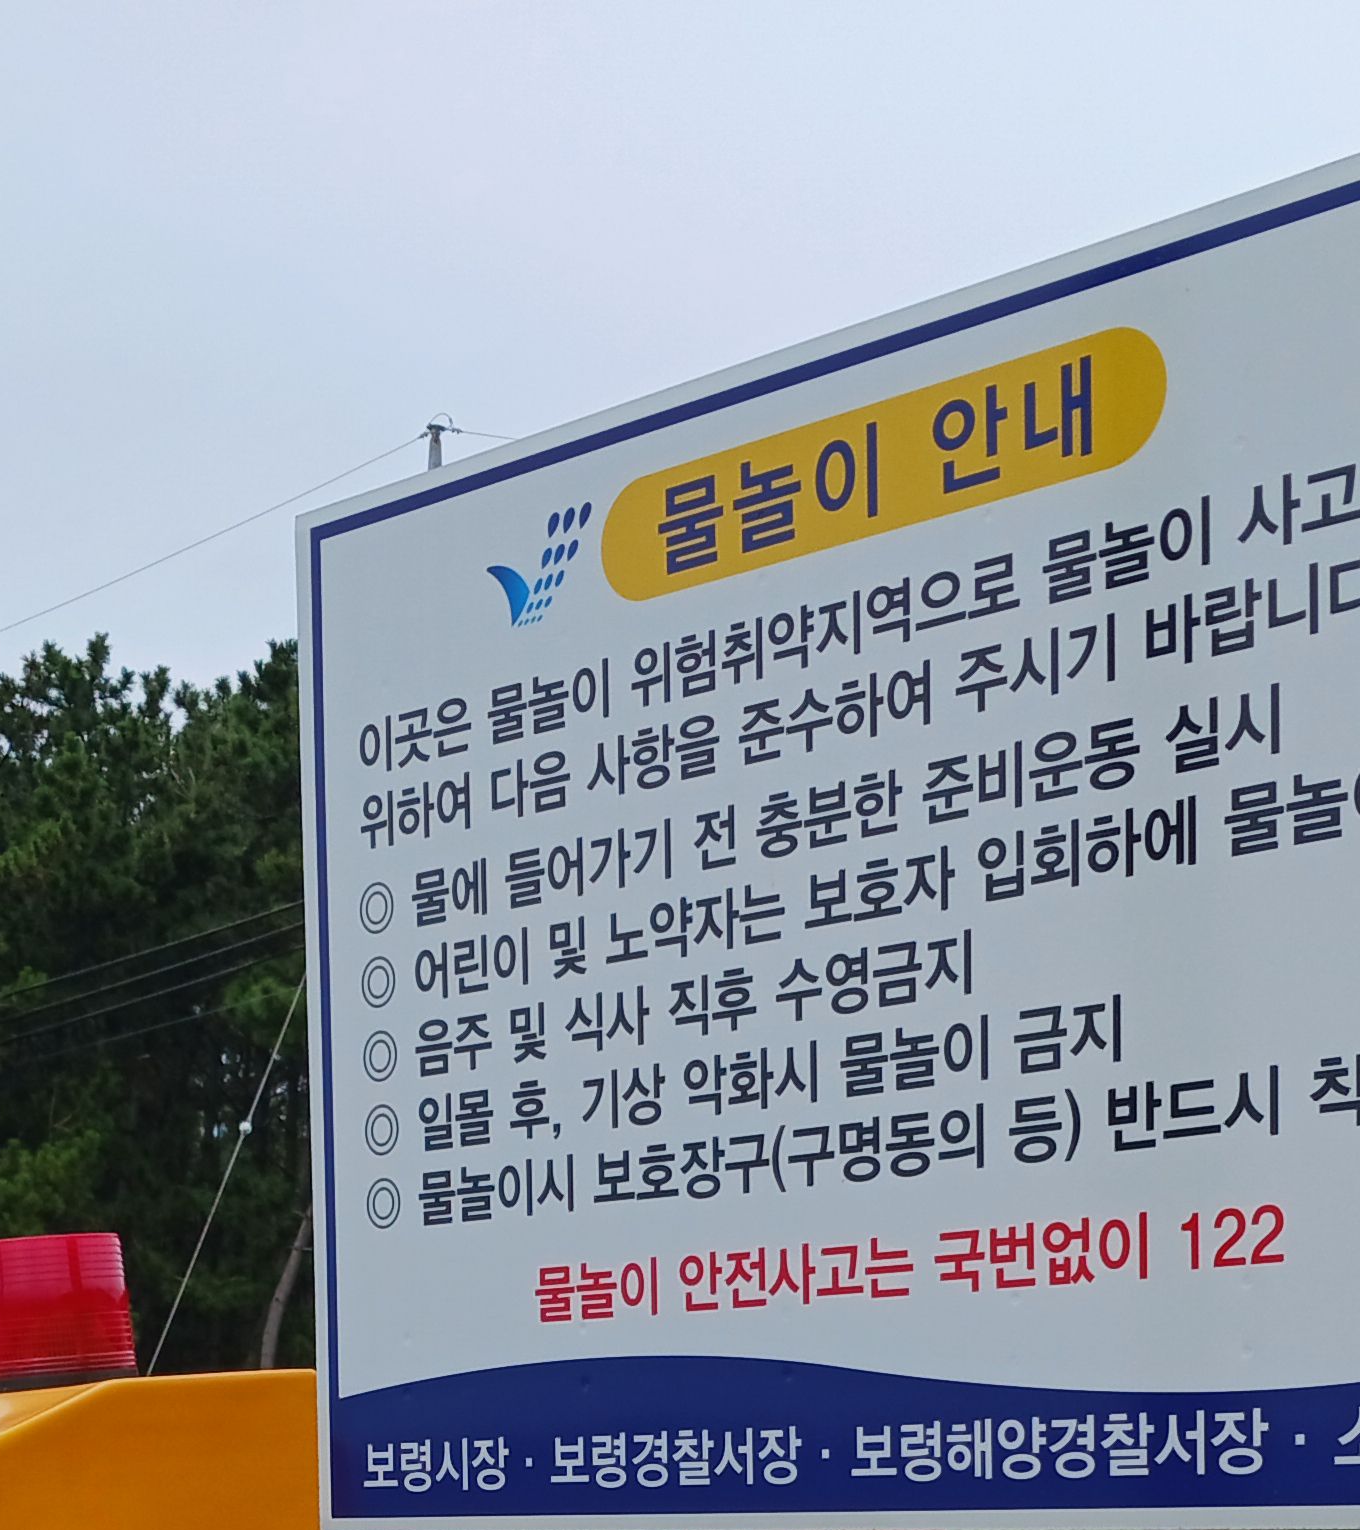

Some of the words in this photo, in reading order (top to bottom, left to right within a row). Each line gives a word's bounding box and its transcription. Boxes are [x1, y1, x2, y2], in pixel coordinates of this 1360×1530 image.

[658, 422, 878, 575] 물놀이
[933, 355, 1092, 494] 안내
[360, 698, 472, 771] 이곳은
[487, 658, 609, 745] 물놀이
[631, 553, 1020, 707] 위험취약지역으로
[1043, 495, 1210, 604] 물놀이
[361, 772, 471, 849] 위하여
[491, 751, 570, 817] 다음
[587, 715, 720, 795] 사항을
[739, 659, 930, 765] 준수하여
[956, 613, 1116, 712] 주시기
[412, 858, 487, 927] 물에
[505, 818, 671, 909] 들어가기
[694, 804, 736, 870] 전
[756, 769, 903, 858] 충분한
[922, 718, 1140, 825] 준비운동
[1165, 683, 1280, 774] 실시
[415, 927, 528, 999] 어린이
[550, 916, 587, 979] 및
[606, 885, 785, 964] 노약자는
[805, 845, 955, 929] 보호자
[978, 795, 1196, 902] 입회하에
[415, 1013, 492, 1077] 음주
[510, 1002, 547, 1064] 및
[565, 985, 650, 1051] 식사
[669, 968, 757, 1036] 직후
[776, 929, 972, 1021] 수영금지
[419, 1089, 494, 1152] 일몰
[510, 1080, 560, 1139] 후,
[583, 1063, 666, 1128] 기상
[684, 1040, 817, 1115] 악화시
[840, 1014, 989, 1098] 물놀이
[1014, 994, 1121, 1074] 금지
[418, 1154, 574, 1226] 물놀이시
[593, 1103, 984, 1203] 보호장구(구명동의
[1009, 1088, 1081, 1163] 등)
[1108, 1065, 1279, 1152] 반드시
[535, 1257, 658, 1322] 물놀이
[679, 1238, 913, 1312] 안전사고는
[934, 1211, 1148, 1292] 국번없이
[1181, 1204, 1284, 1269] 122
[363, 1436, 509, 1492] 보령시장
[550, 1425, 802, 1488] 보령경찰서장
[851, 1408, 1268, 1482] 보령해양경찰서장
